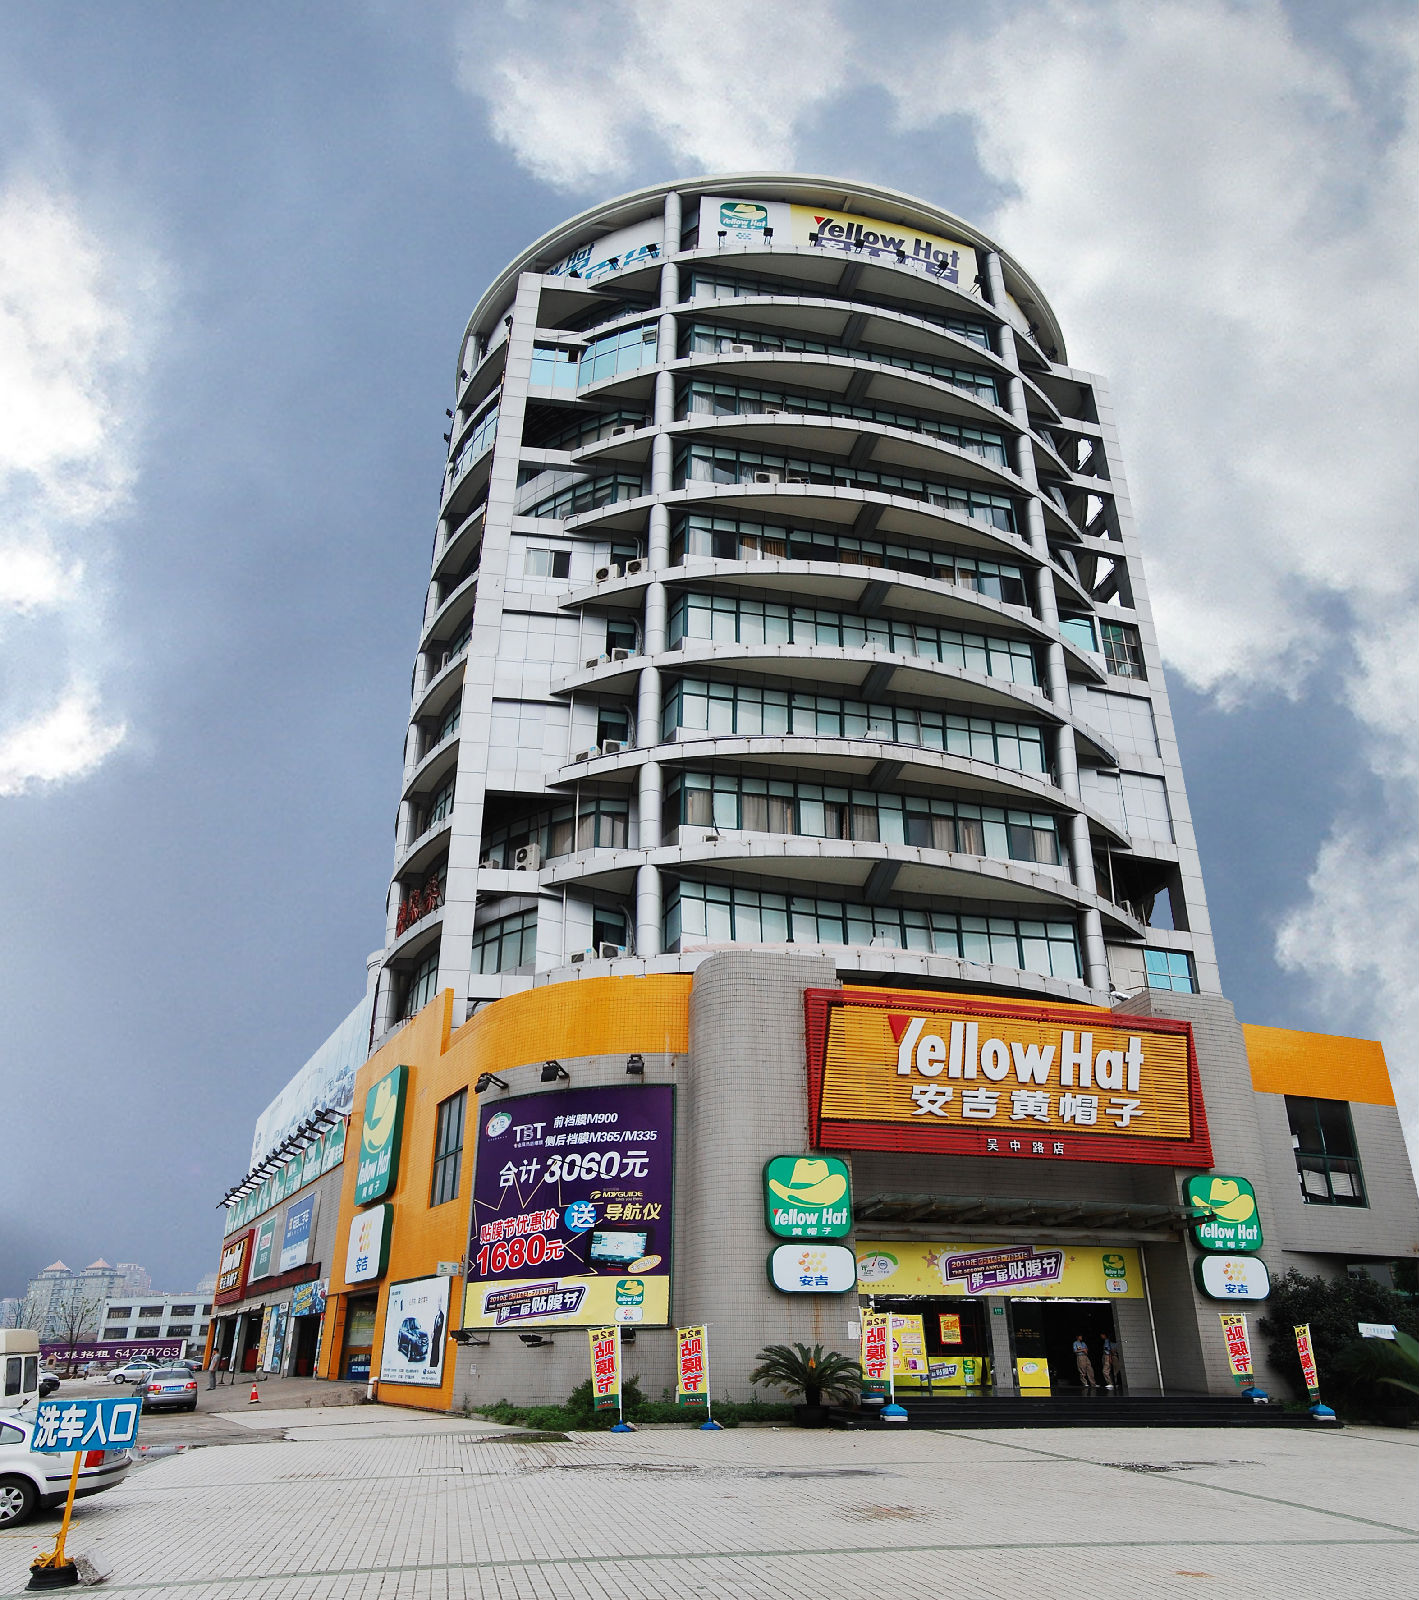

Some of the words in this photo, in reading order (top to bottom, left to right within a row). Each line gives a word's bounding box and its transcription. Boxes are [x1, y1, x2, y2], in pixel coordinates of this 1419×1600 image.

[814, 216, 905, 251] Yellow
[913, 238, 960, 268] Hat
[888, 1014, 1056, 1085] Yellow
[1060, 1030, 1144, 1092] Hat
[911, 1083, 1145, 1128] 安吉黄帽子
[553, 1113, 618, 1129] 前档膜M900
[513, 1122, 547, 1142] TBT
[545, 1130, 657, 1147] 侧后档膜M365/M335
[986, 1138, 1065, 1154] 吴中路店
[571, 1203, 596, 1228] 送
[604, 1203, 662, 1221] 导航仪
[773, 1208, 819, 1225] Yellow
[822, 1208, 848, 1225] Hat
[479, 1208, 560, 1245] 贴膜节优惠价
[1199, 1223, 1235, 1239] Yellow
[1237, 1224, 1258, 1240] Hat
[355, 1255, 369, 1273] 安吉
[477, 1235, 565, 1276] 1680元
[799, 1275, 829, 1287] 安吉
[971, 1256, 1057, 1289] 第二届贴膜节
[1225, 1283, 1249, 1294] 安吉
[500, 1292, 580, 1321] 第二届贴膜节
[115, 1347, 179, 1359] 54778763
[33, 1403, 137, 1448] 洗车入口
